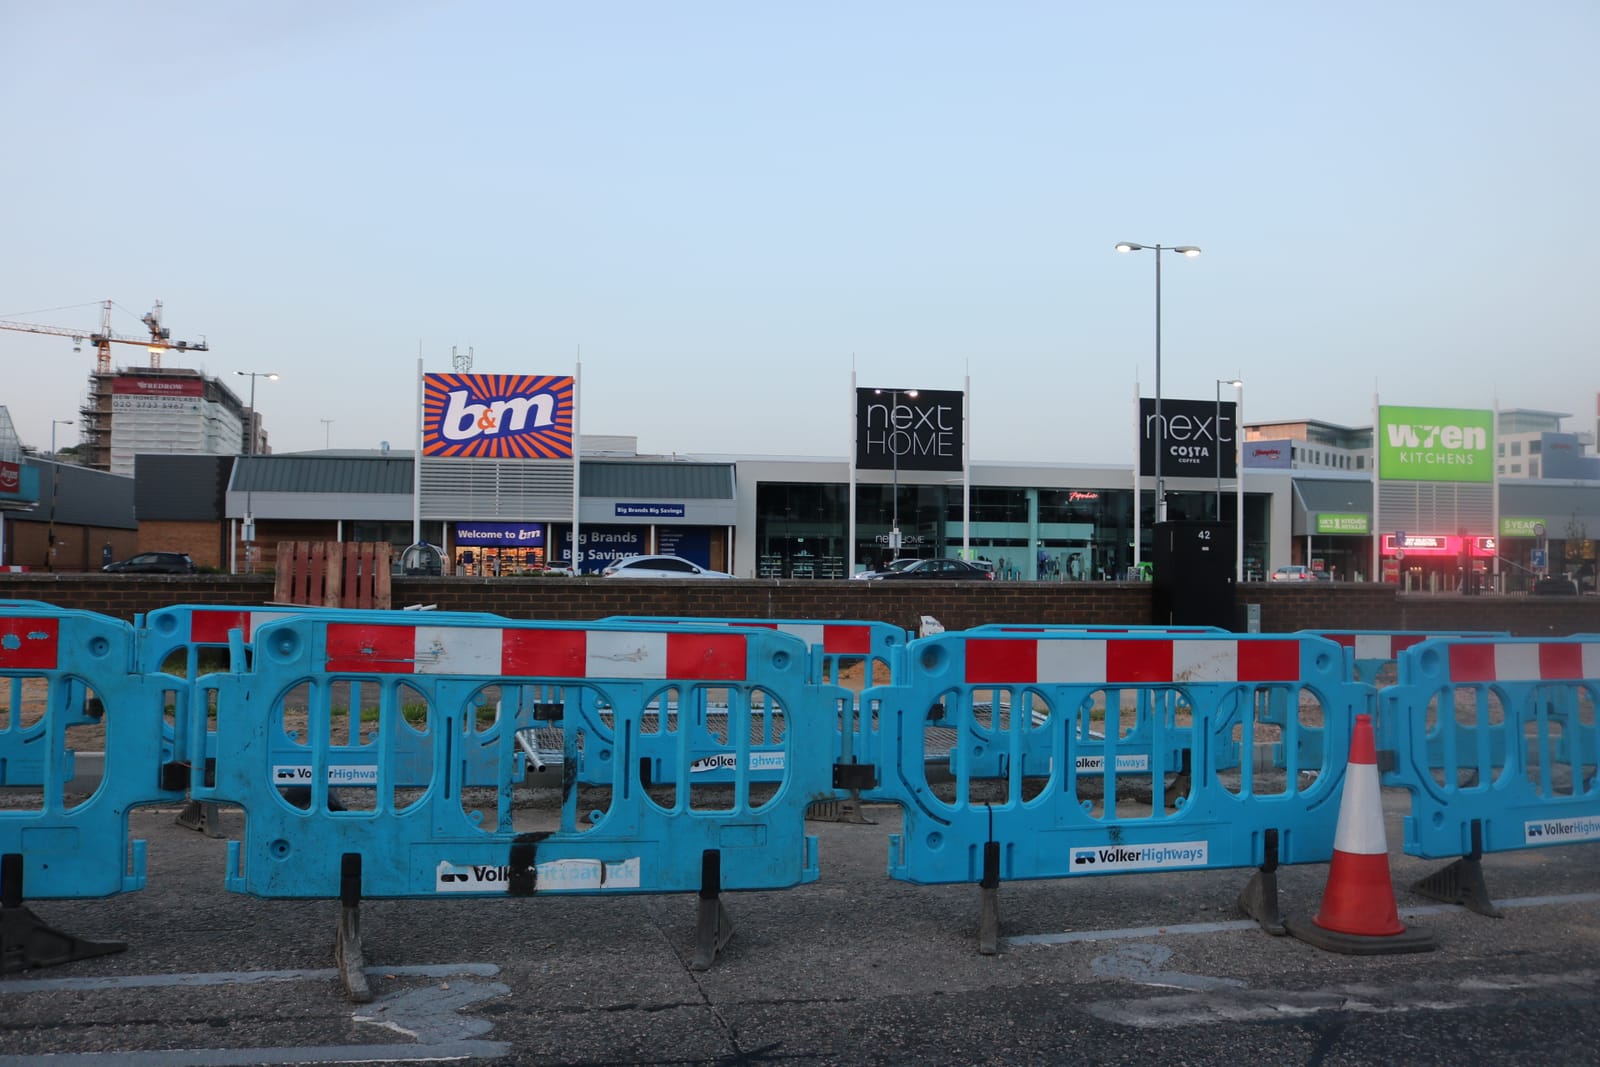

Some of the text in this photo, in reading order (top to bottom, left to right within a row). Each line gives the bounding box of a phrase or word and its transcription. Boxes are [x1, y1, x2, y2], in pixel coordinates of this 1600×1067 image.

[147, 382, 183, 390] REDROW
[443, 390, 554, 440] b&m
[867, 404, 954, 431] next
[1146, 414, 1232, 442] next
[867, 430, 954, 456] HOME
[1387, 423, 1487, 451] wren
[1170, 445, 1209, 458] COSTA
[1400, 451, 1474, 465] KITCHENS
[617, 506, 627, 514] Big
[458, 530, 502, 539] Welcome
[505, 531, 516, 539] to
[566, 532, 638, 544] Bg Brands
[1198, 530, 1211, 540] 42
[563, 549, 640, 561] Bg Savings
[1099, 847, 1204, 863] VolkerHighways
